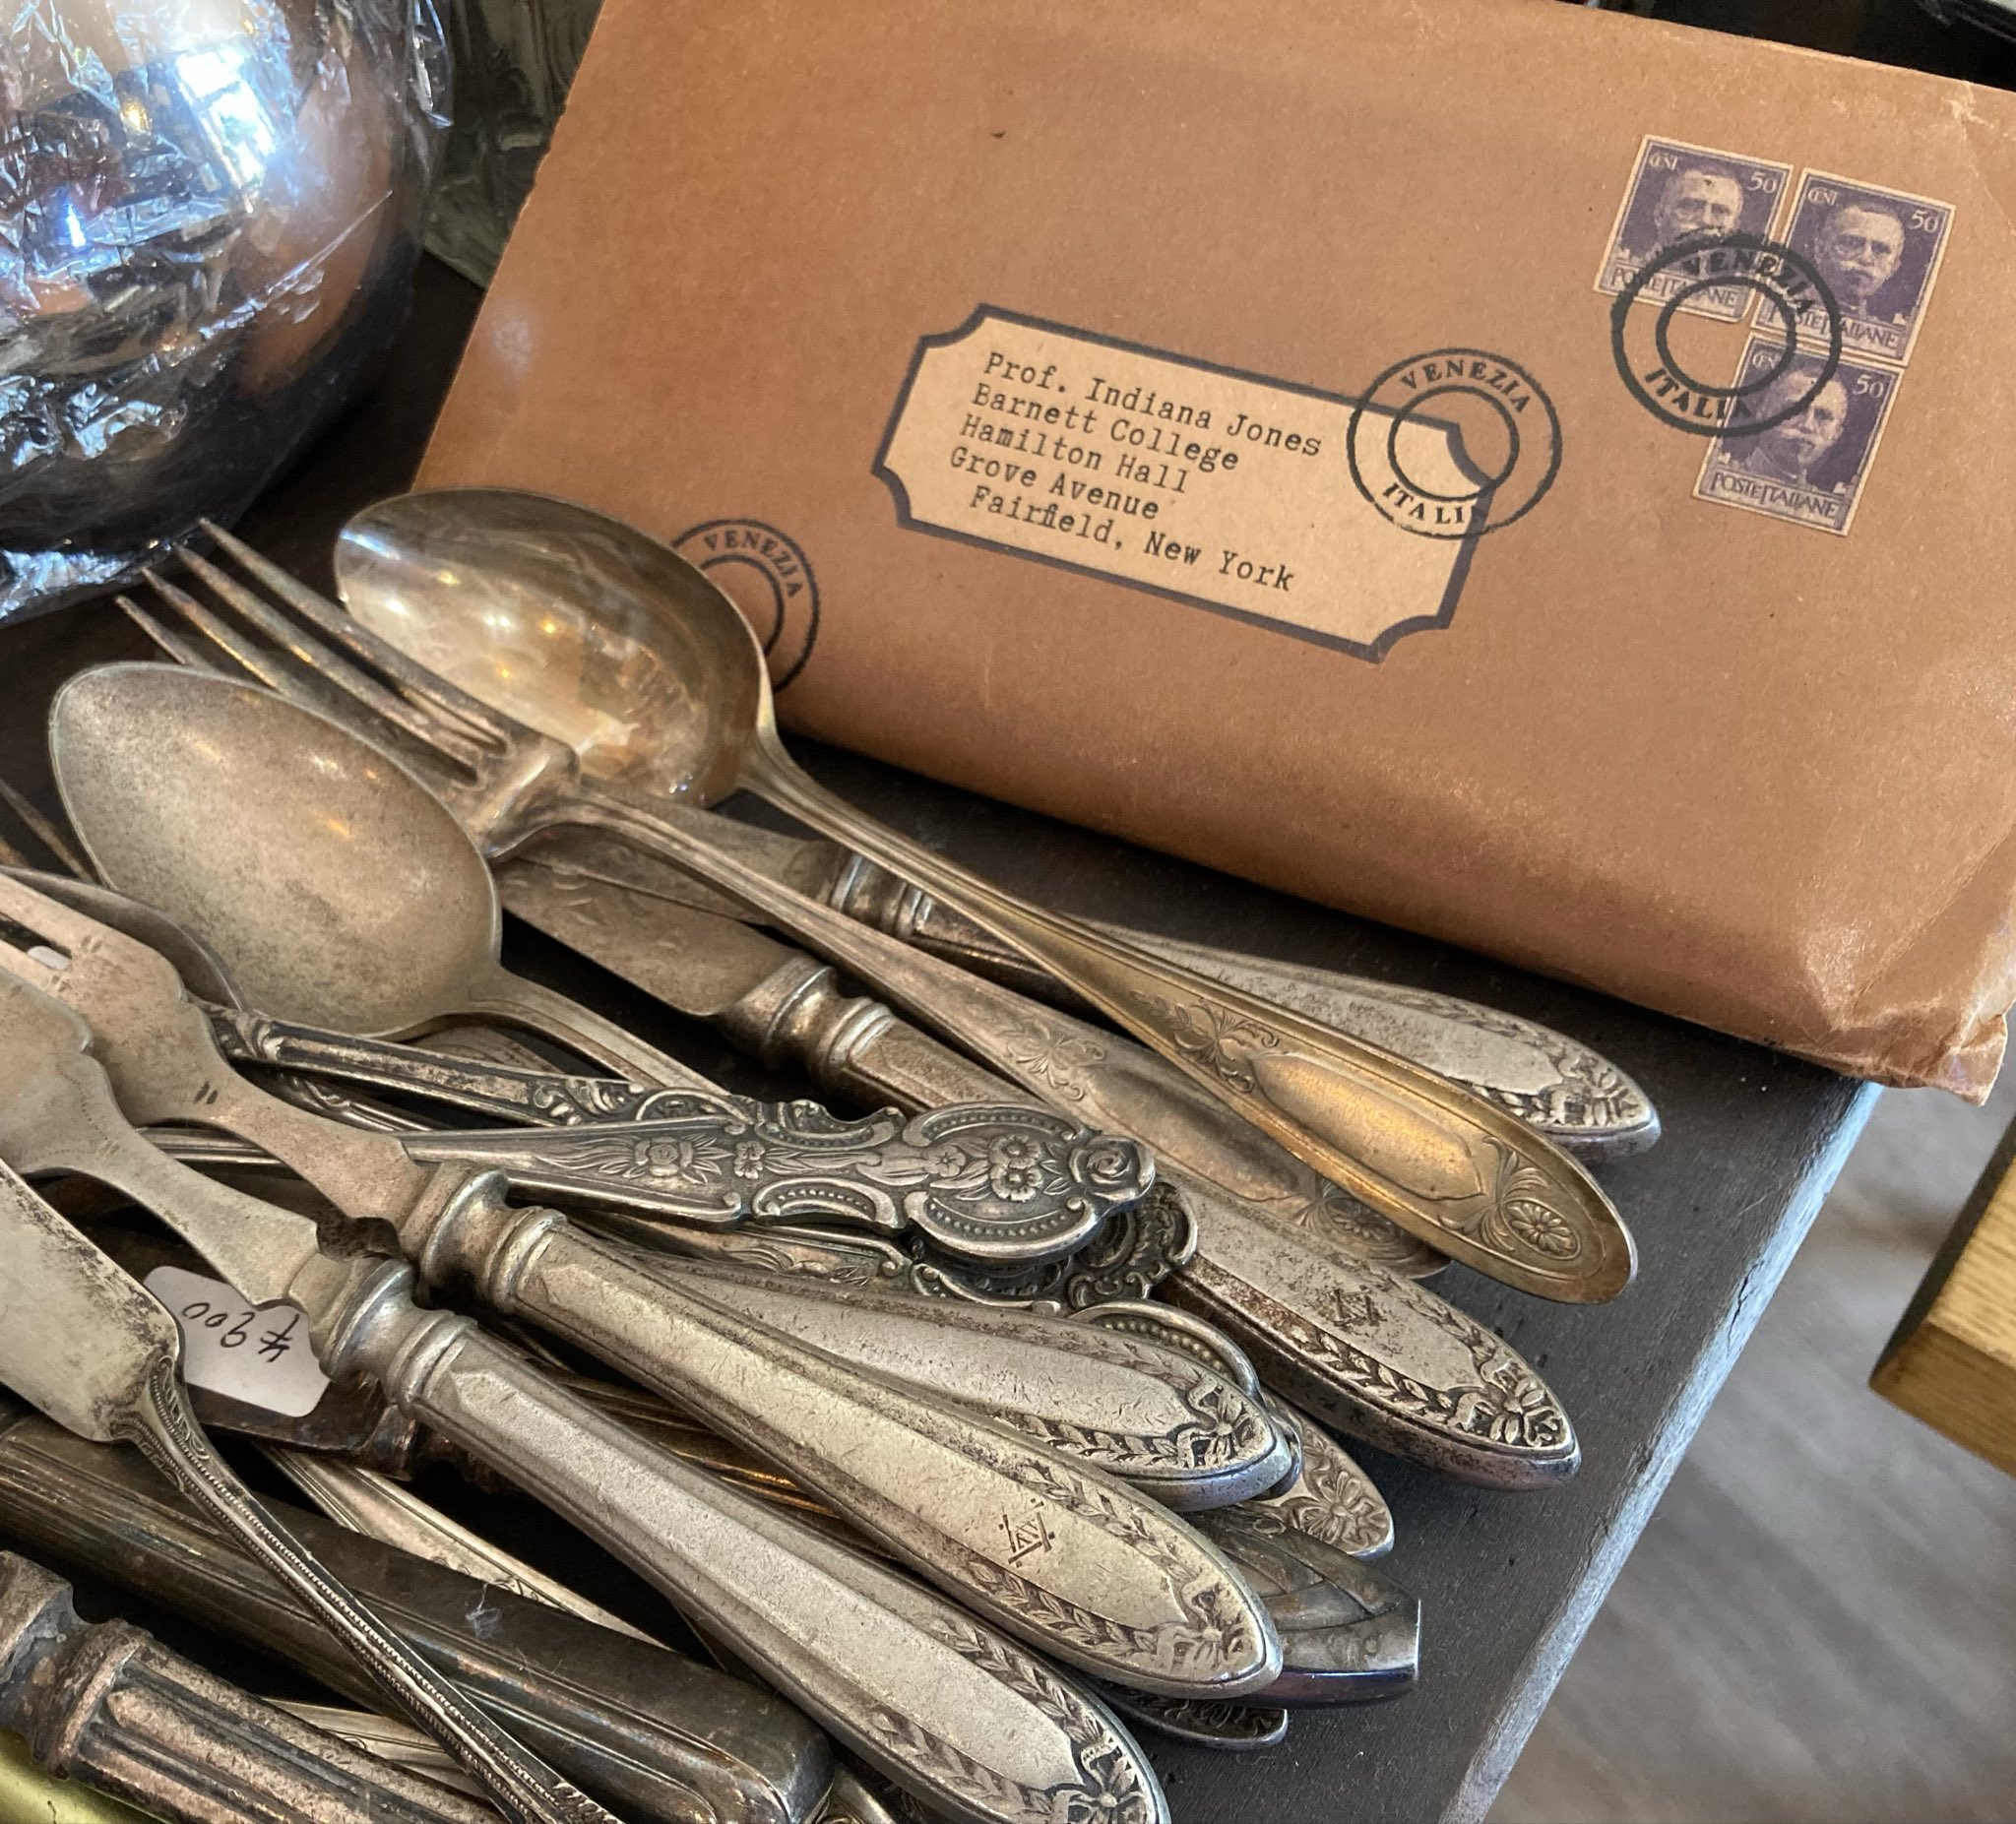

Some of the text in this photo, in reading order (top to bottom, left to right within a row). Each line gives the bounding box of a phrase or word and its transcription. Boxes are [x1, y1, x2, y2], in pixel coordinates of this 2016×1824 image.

[1746, 170, 1778, 194] 50
[1908, 209, 1939, 234] 50
[1681, 249, 1814, 314] VENEZIA
[983, 351, 1322, 457] Prof. Indiana Jones
[1399, 358, 1530, 413] VENEZIA
[1644, 366, 1752, 419] ITALIA
[1851, 374, 1884, 399] 50
[959, 412, 1189, 494] Hamilton Hall
[972, 382, 1239, 473] Barnett College
[950, 445, 1160, 520] Grove Avenue
[704, 530, 804, 598] VENEZIA
[969, 484, 1295, 593] Fairfield, New York
